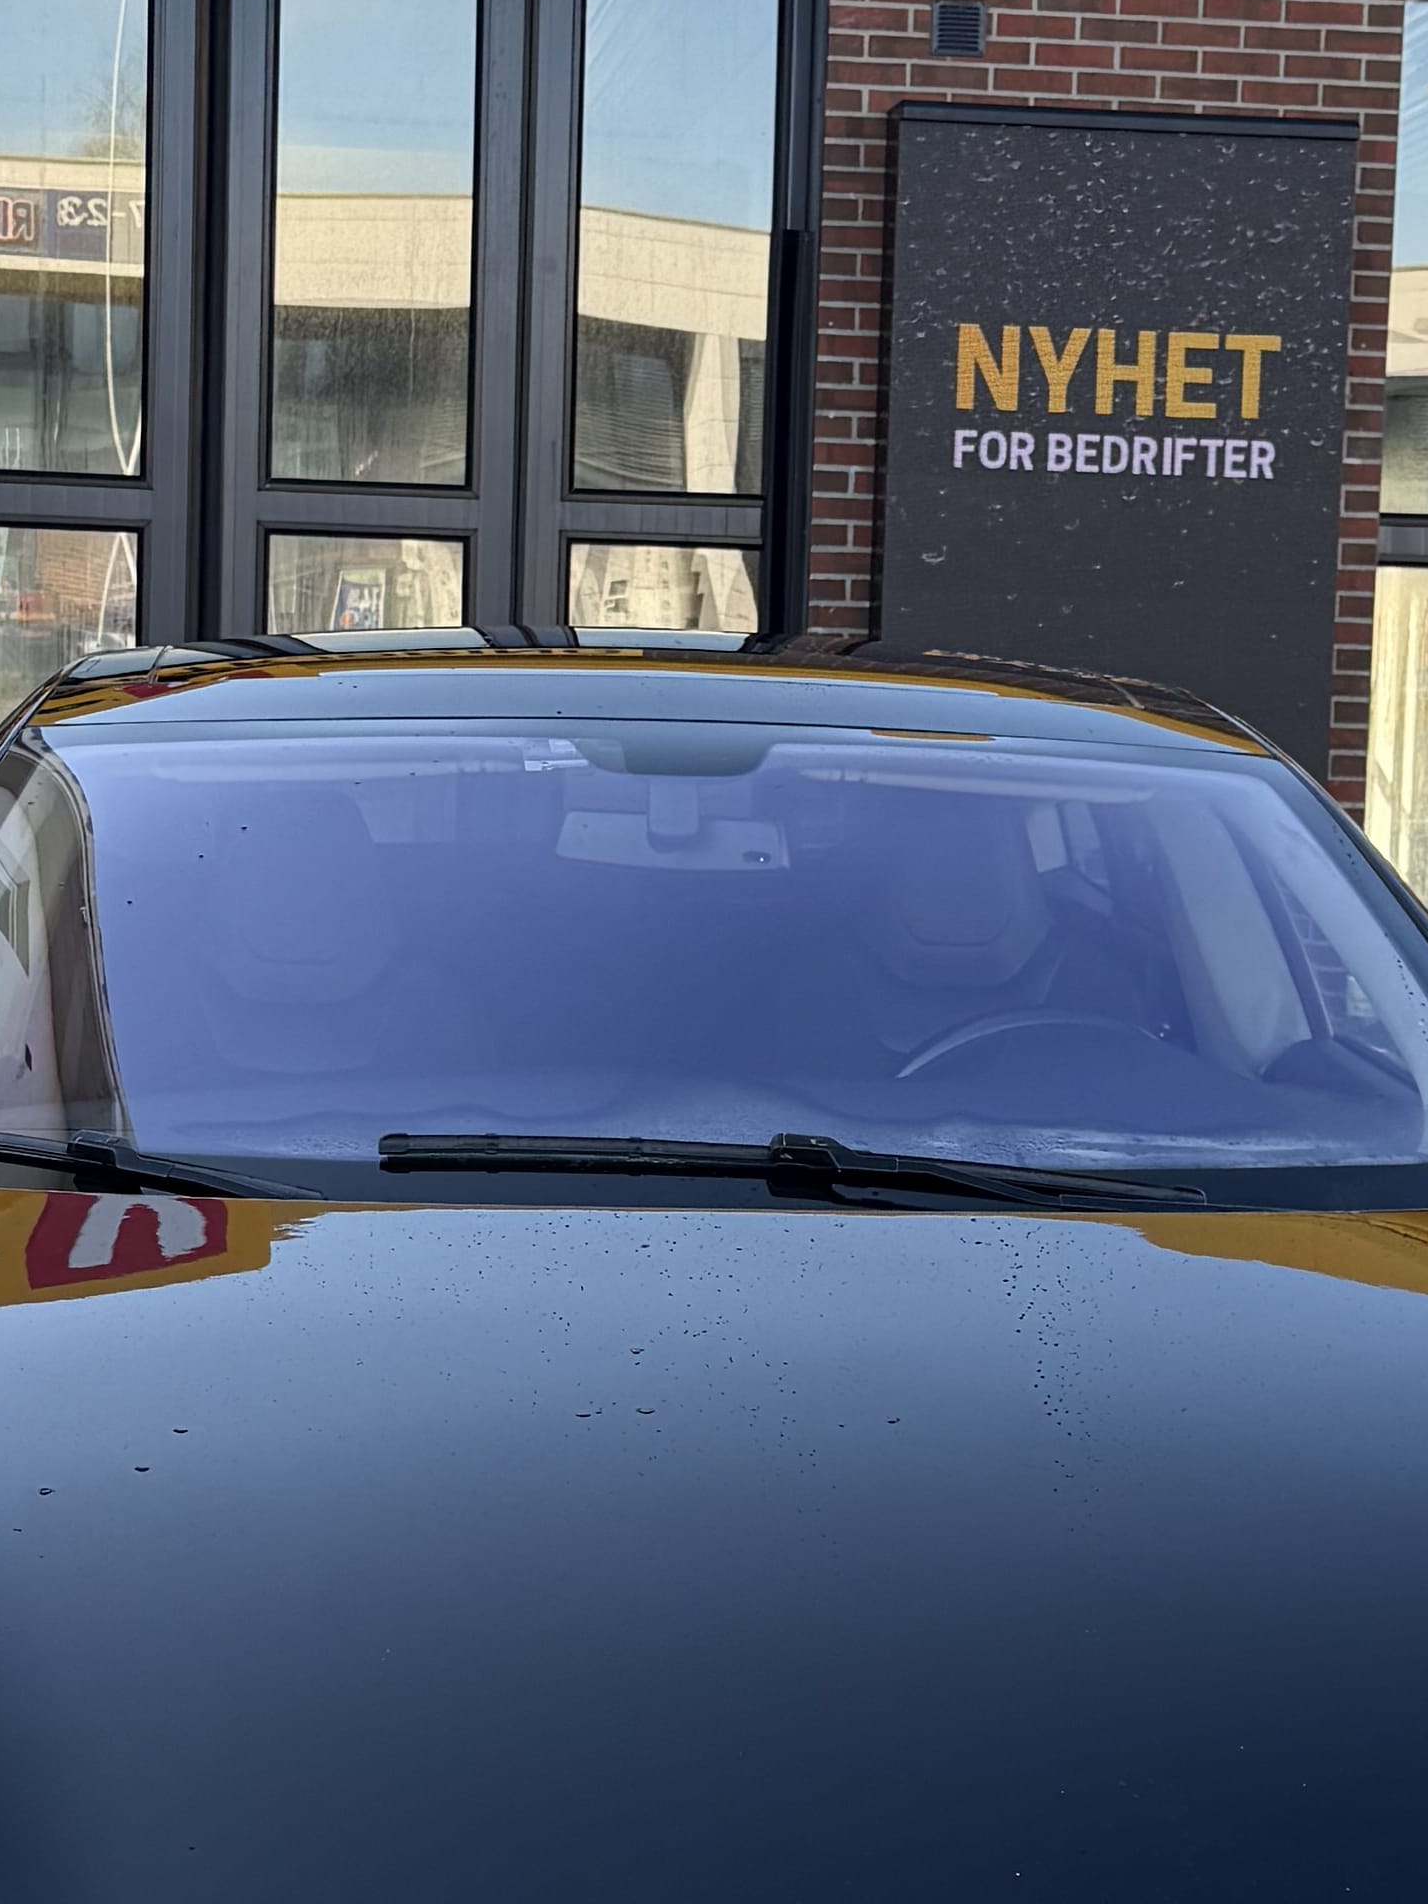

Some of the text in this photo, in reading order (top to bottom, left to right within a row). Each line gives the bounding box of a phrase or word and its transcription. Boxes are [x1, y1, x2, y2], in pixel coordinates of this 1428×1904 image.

[955, 323, 1281, 421] NYHET
[953, 429, 1276, 480] FOR BEDRIFTER
